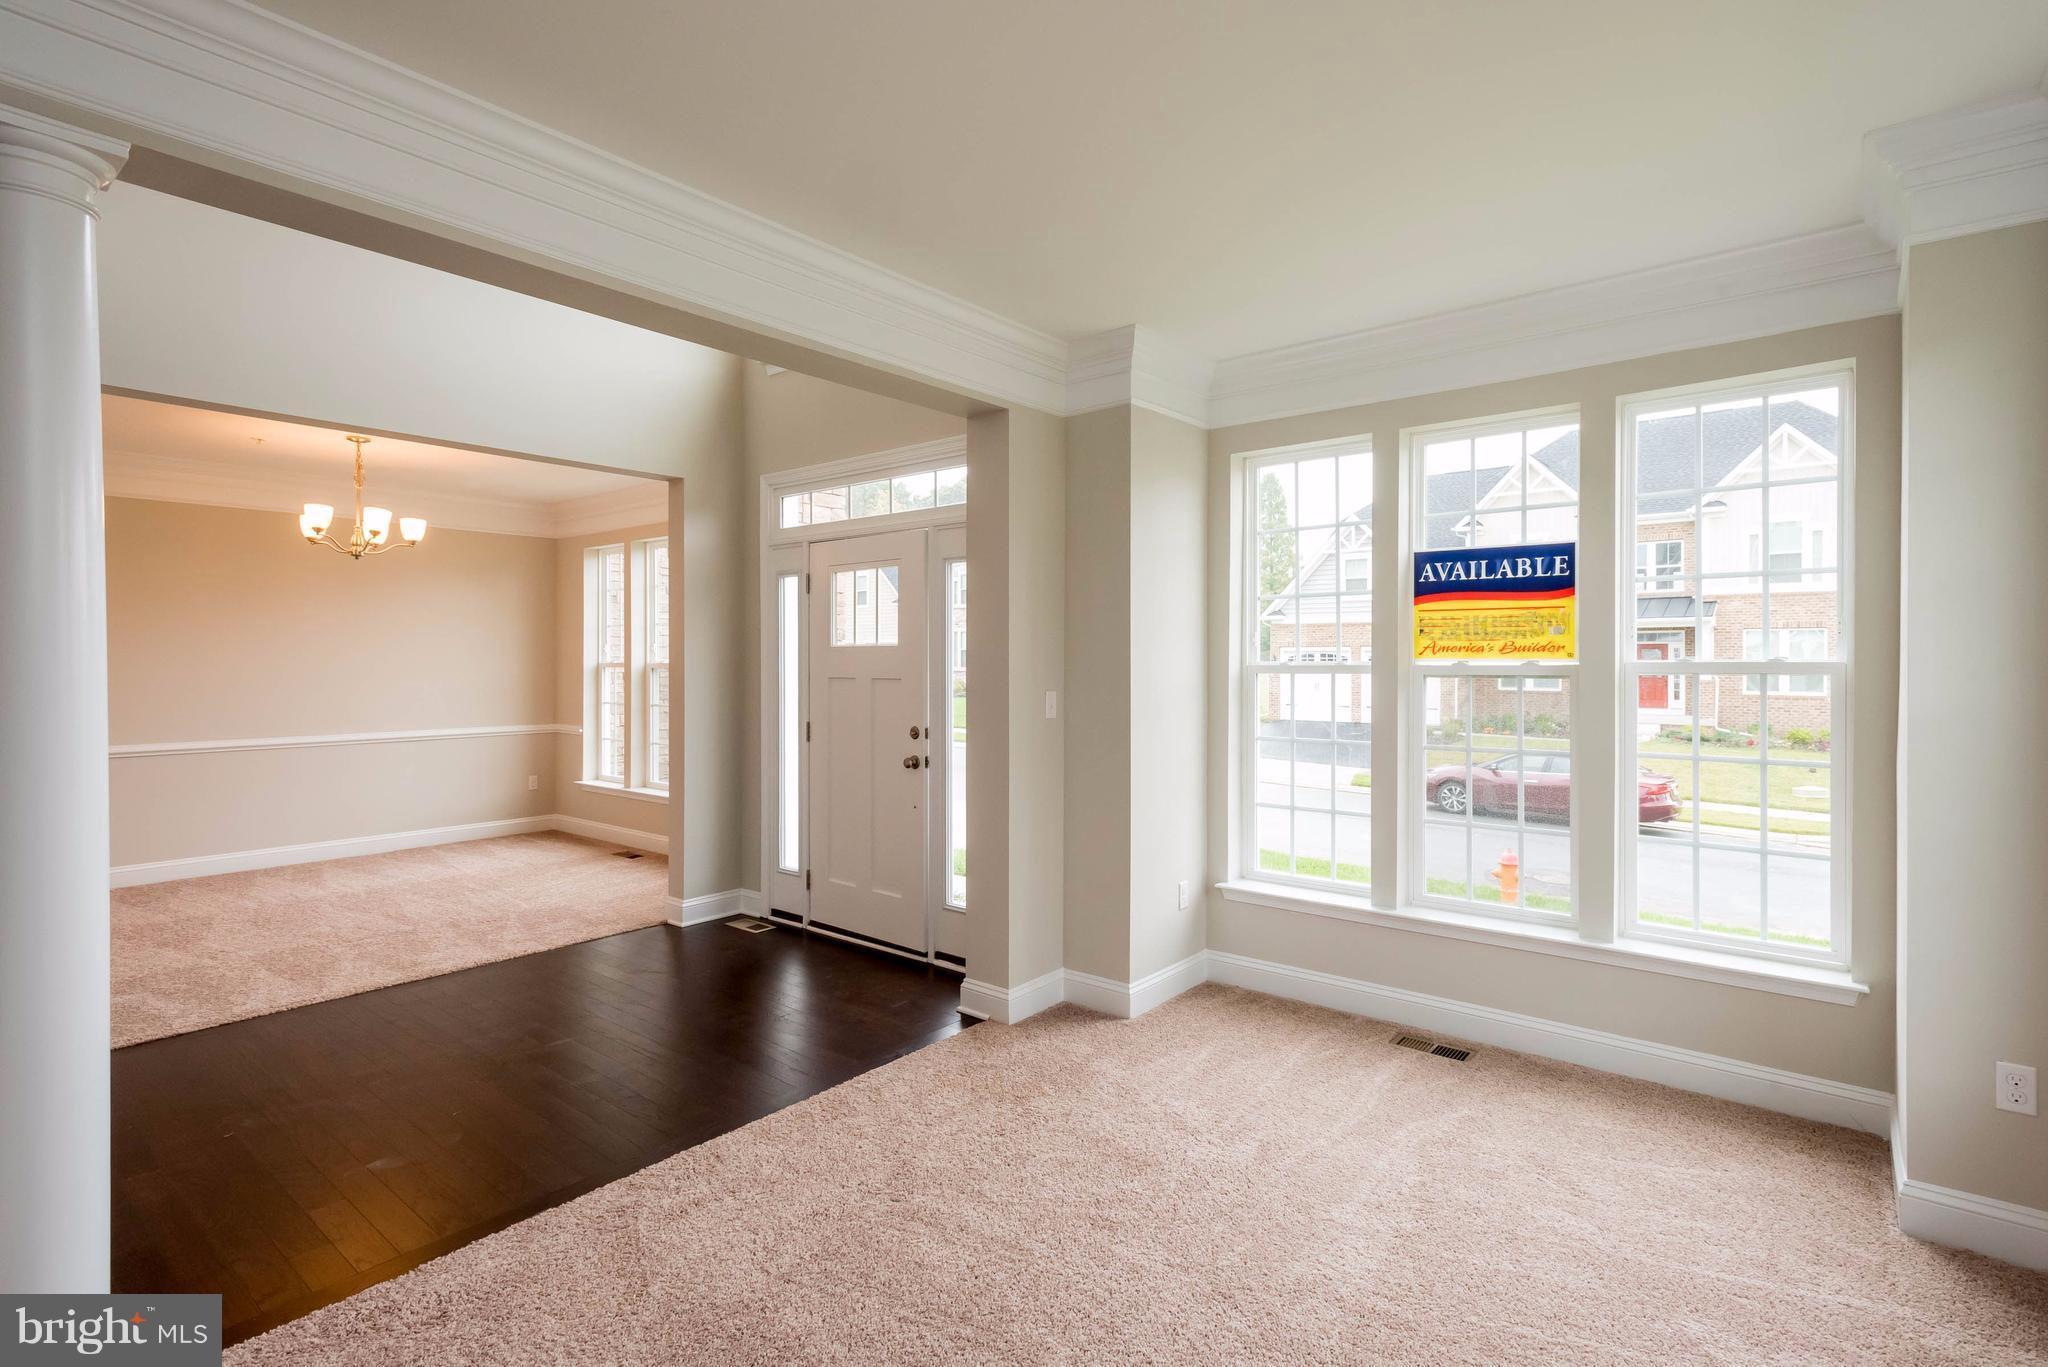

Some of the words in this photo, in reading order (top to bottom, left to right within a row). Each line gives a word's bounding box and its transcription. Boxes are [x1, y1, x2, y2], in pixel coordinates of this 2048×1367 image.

[1418, 555, 1570, 583] AVAILABLE
[1418, 640, 1494, 656] America's
[1498, 640, 1566, 655] Builder
